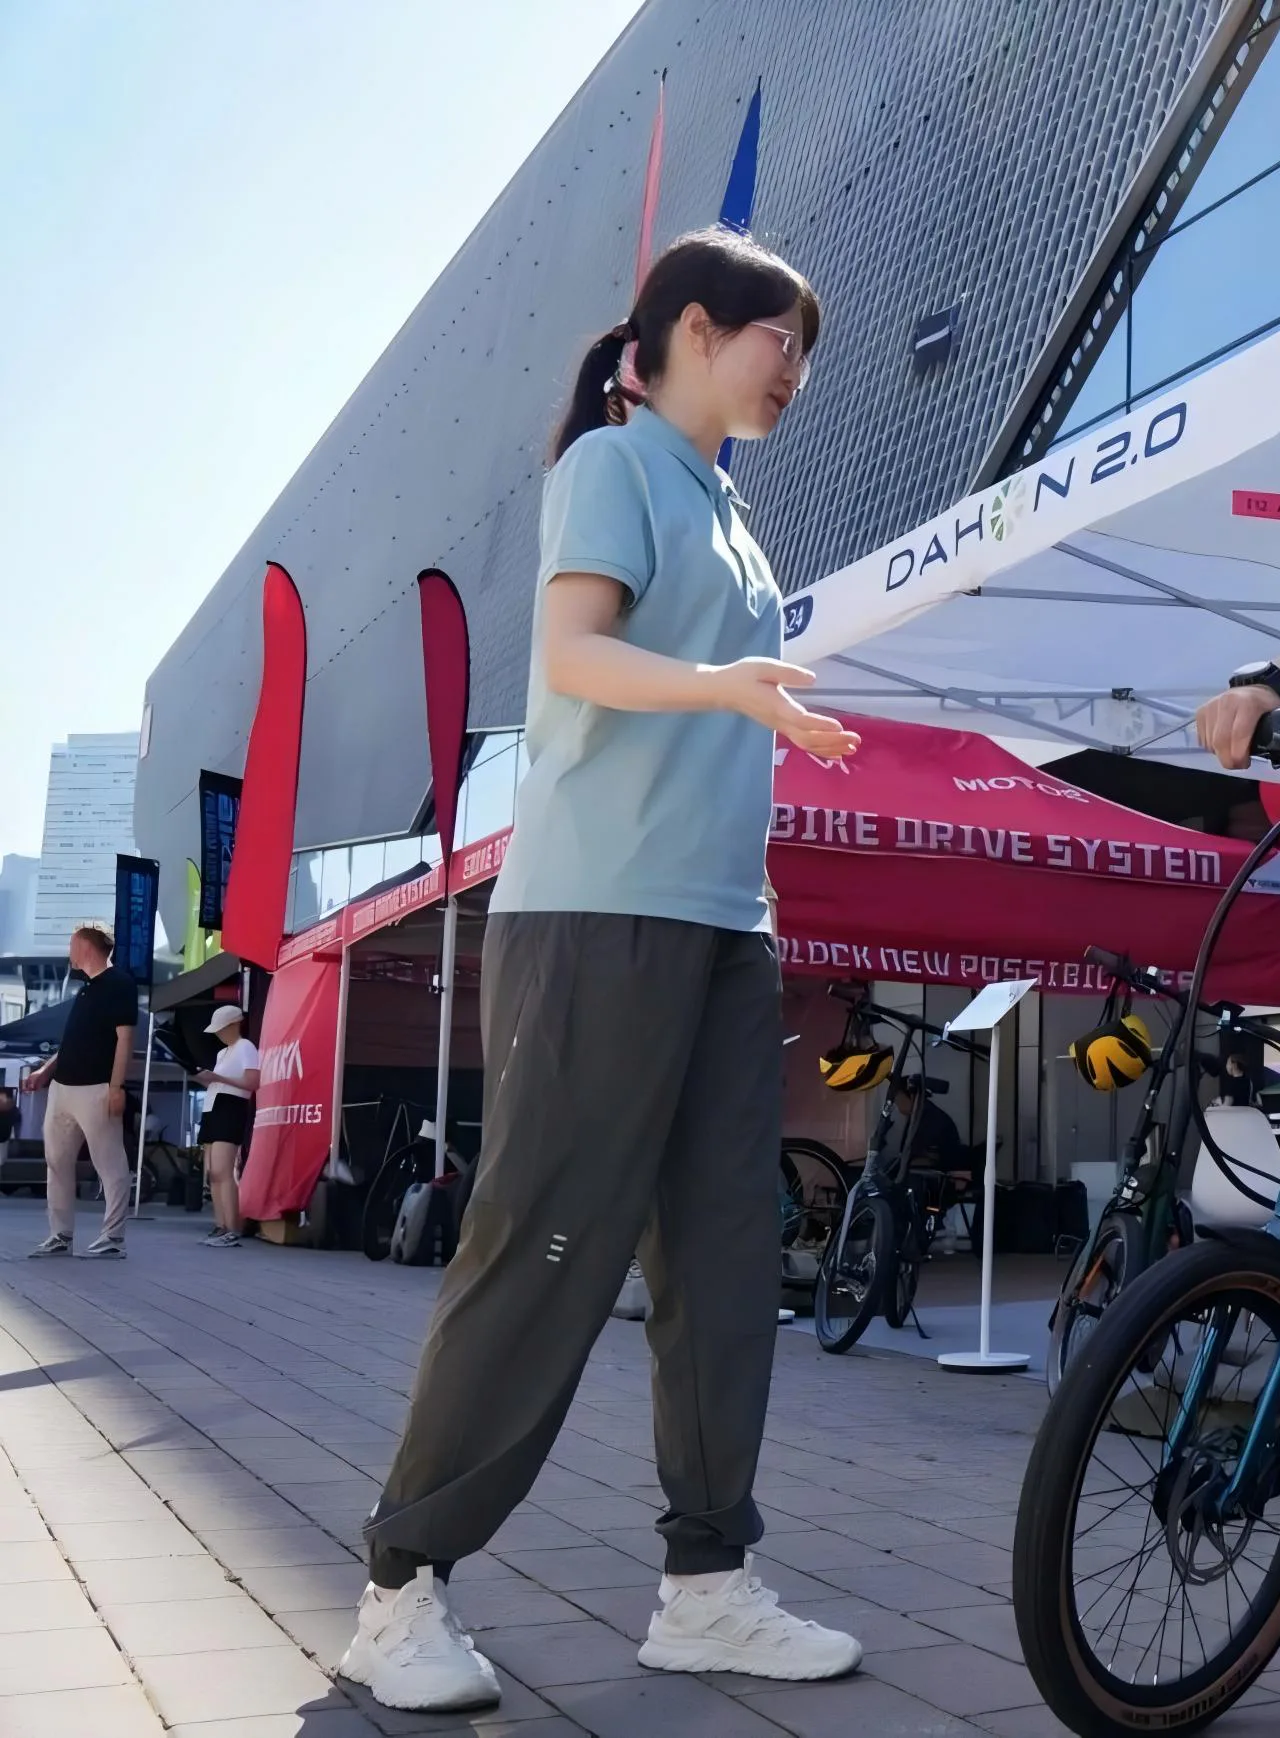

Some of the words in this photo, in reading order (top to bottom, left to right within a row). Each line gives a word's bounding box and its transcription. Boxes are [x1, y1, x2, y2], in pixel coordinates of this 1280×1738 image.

[886, 457, 1075, 593] DAHON
[1090, 401, 1187, 485] 2.0
[768, 802, 879, 846] BIKE
[895, 815, 1034, 862] DRIVE
[1046, 834, 1222, 884] SYSTEM
[880, 946, 950, 977] NEW
